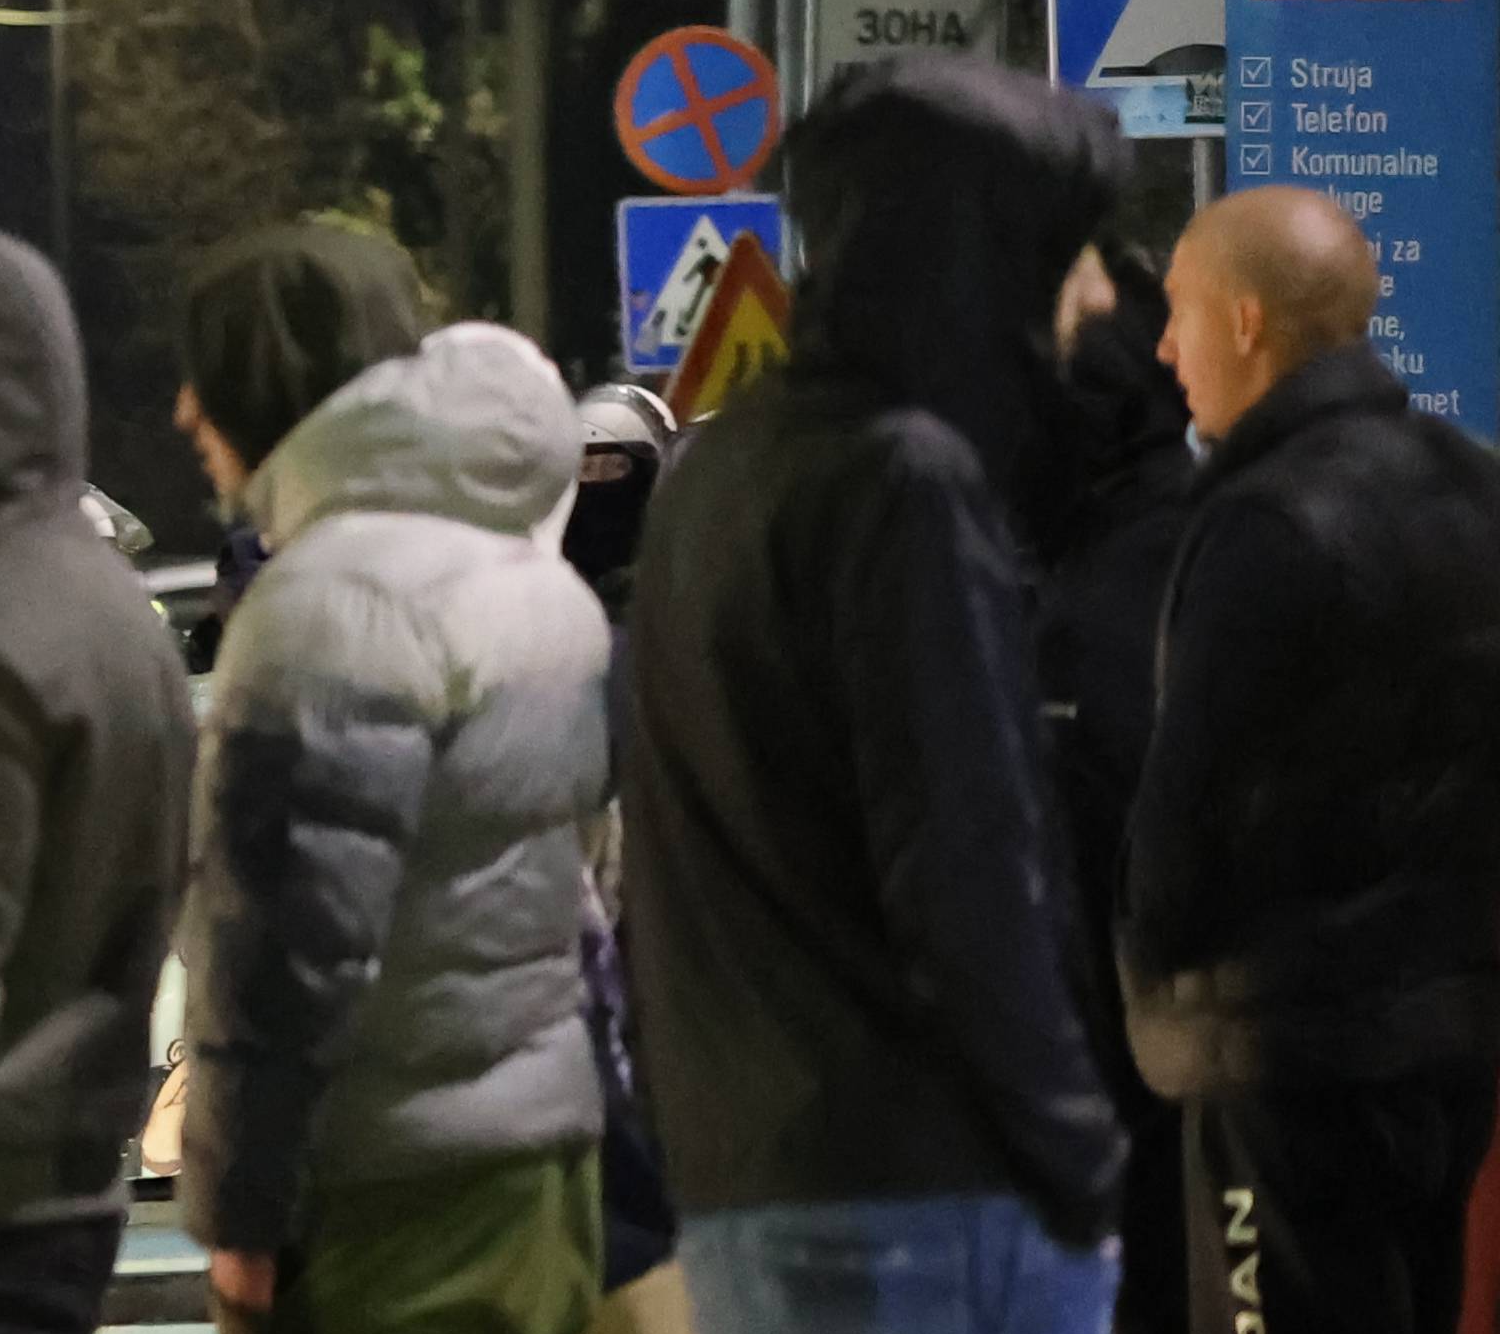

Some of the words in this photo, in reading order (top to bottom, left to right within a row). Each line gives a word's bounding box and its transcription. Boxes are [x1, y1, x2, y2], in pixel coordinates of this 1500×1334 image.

[1290, 58, 1373, 95] Struja
[1290, 102, 1388, 133] Telefon
[1290, 146, 1439, 177] Komunalne
[1391, 239, 1421, 262] za
